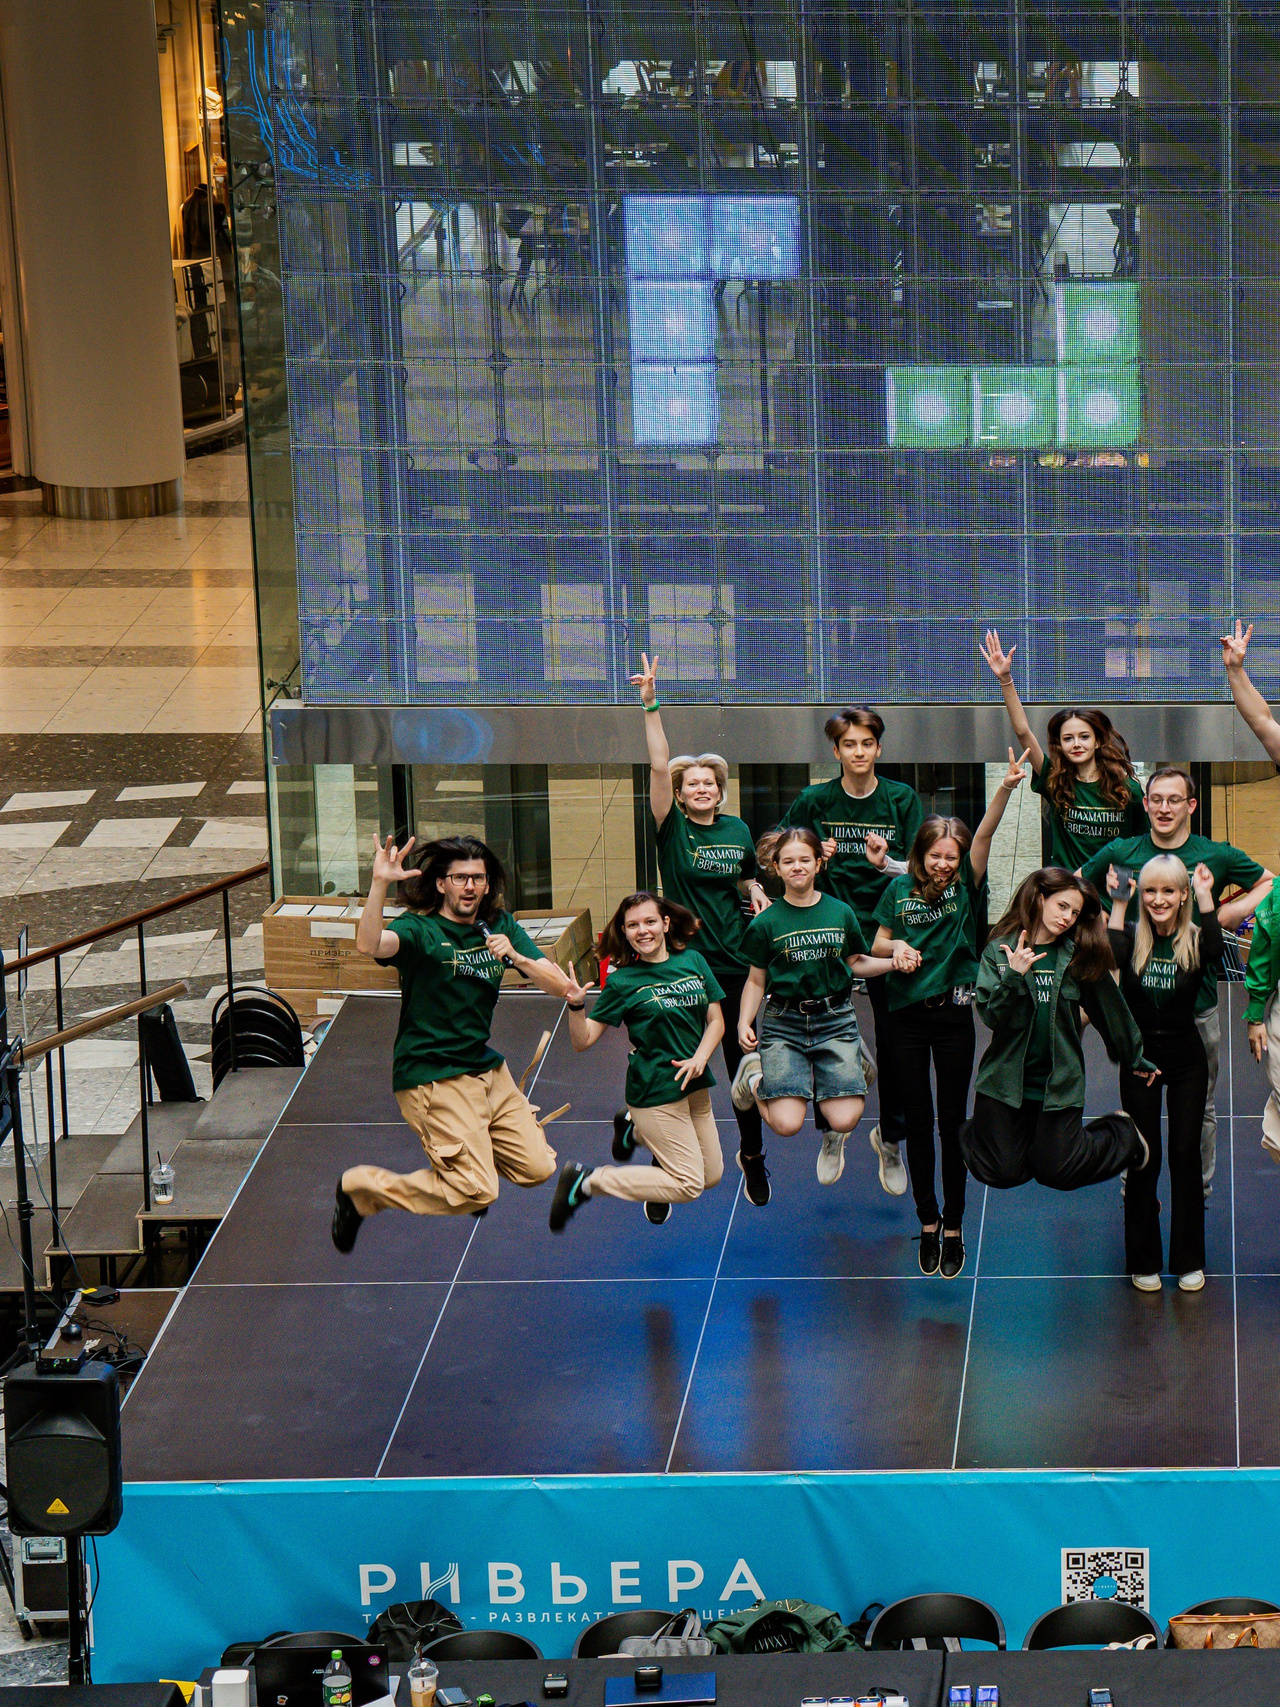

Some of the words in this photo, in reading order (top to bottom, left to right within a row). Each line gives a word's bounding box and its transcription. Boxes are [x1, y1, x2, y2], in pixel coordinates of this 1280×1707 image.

[1068, 808, 1125, 823] ШАХМАТНЫЕ
[1067, 822, 1103, 837] ЗВЕЗДЫ
[836, 842, 867, 855] ЗВЕЗД
[697, 858, 733, 874] ЗВЕЗДЫ
[906, 908, 942, 925] ЗВЕЗДЫ
[791, 948, 827, 962] ЗВЕЗДЫ
[359, 1559, 766, 1606] РИВЬЕРА
